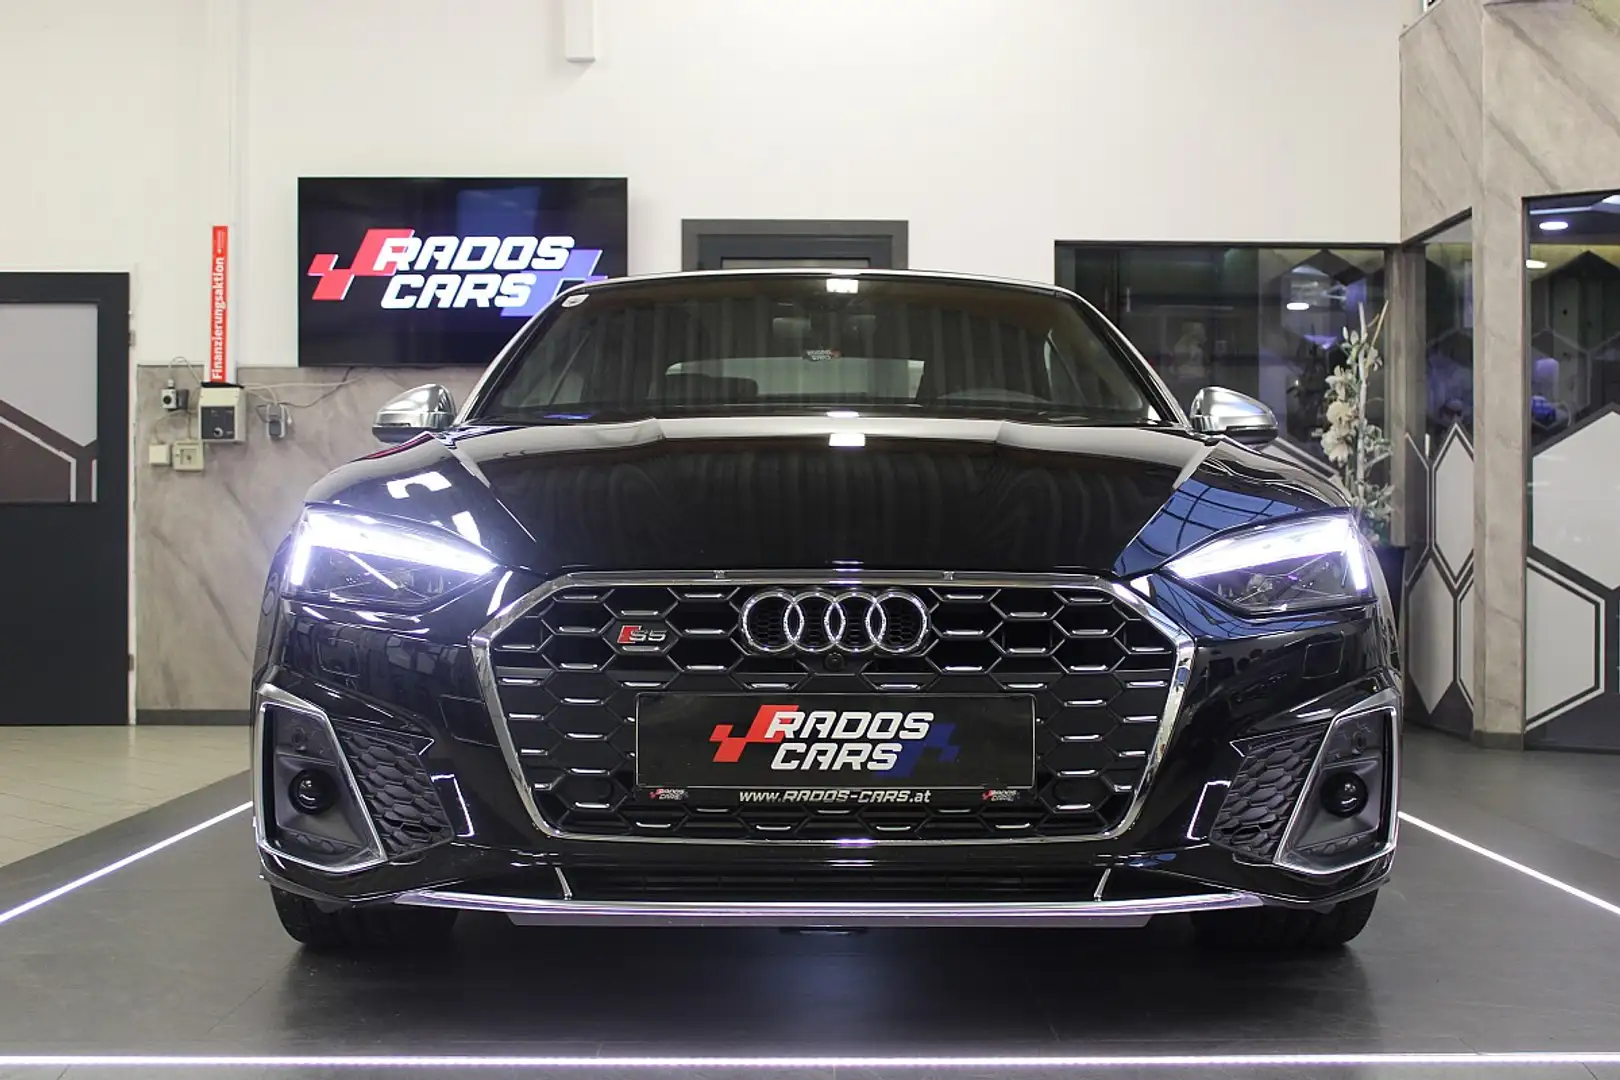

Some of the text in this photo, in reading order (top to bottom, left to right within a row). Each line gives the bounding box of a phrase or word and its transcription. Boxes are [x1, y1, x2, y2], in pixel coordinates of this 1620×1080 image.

[372, 236, 575, 271] RADOS
[381, 273, 536, 309] CARS
[211, 257, 227, 379] Finanzierungsaktion
[626, 628, 667, 642] S5
[764, 711, 934, 739] RADOS
[771, 742, 902, 770] CARS
[739, 789, 931, 803] www.RADOS-CARS.at
